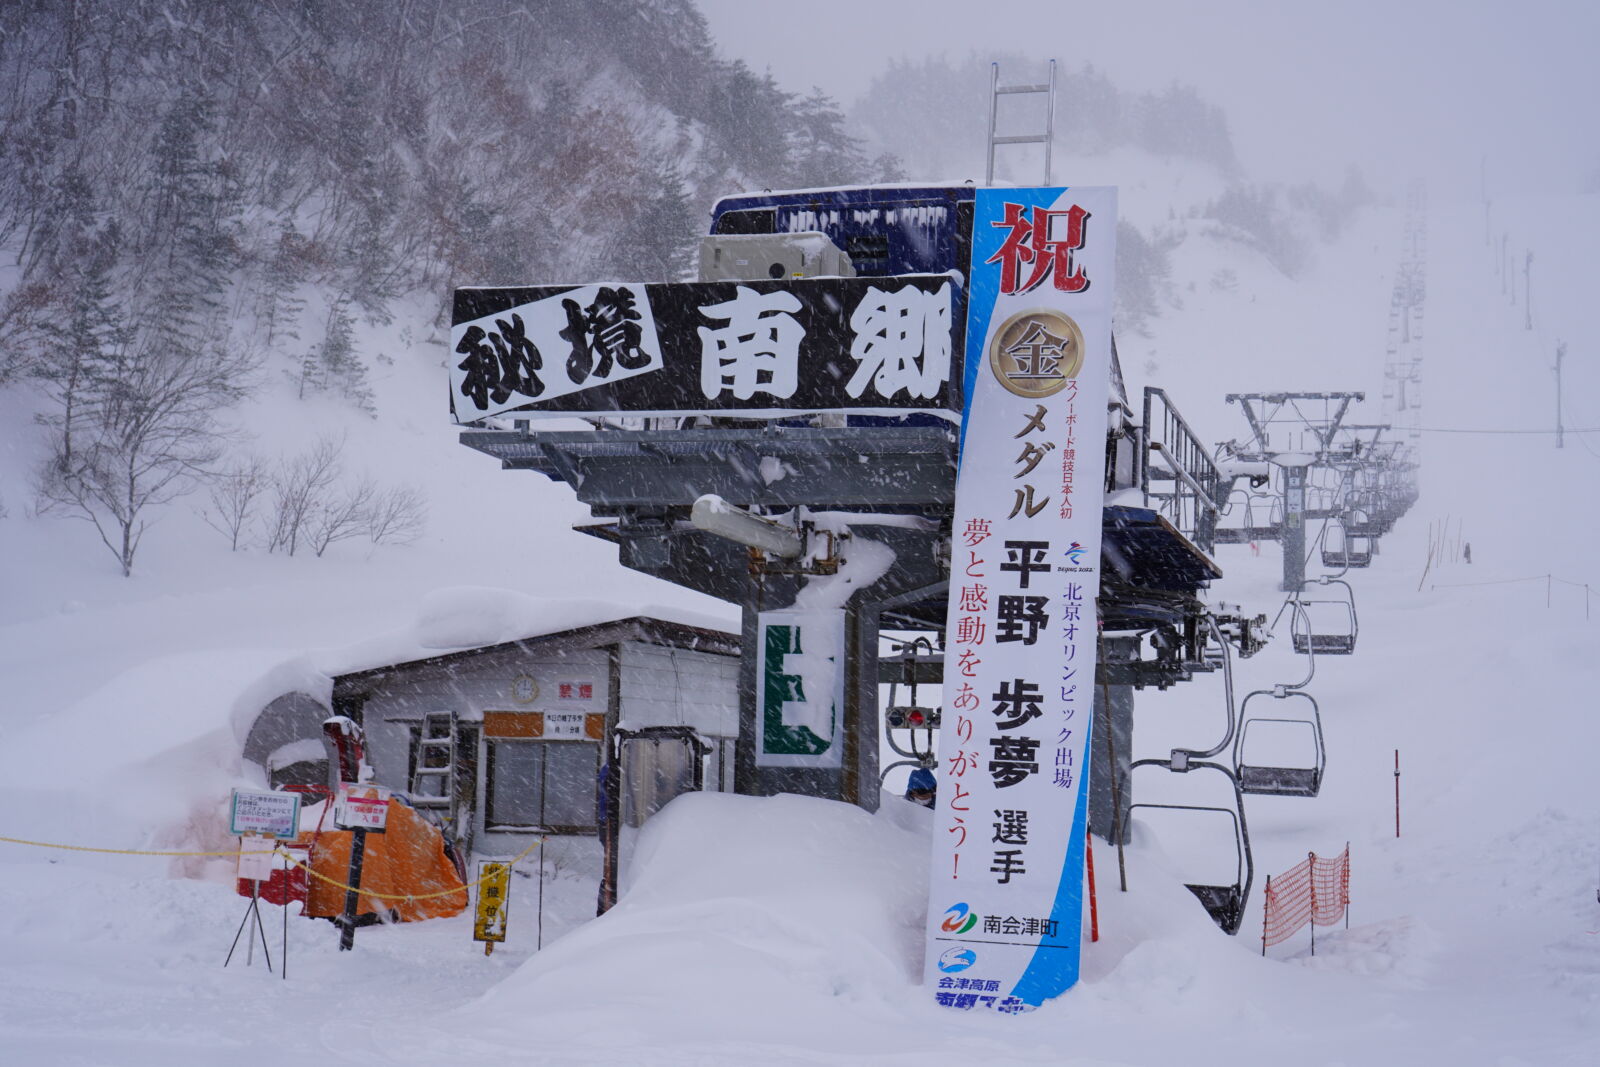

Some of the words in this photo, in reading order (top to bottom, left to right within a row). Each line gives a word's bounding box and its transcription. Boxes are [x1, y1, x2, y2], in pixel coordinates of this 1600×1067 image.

[985, 202, 1091, 295] 祝
[455, 286, 652, 411] 秘境
[696, 281, 953, 401] 南郷
[1005, 320, 1069, 379] 金
[1059, 380, 1078, 519] スノーボード競技日本人初
[559, 683, 593, 699] 禁煙
[1052, 582, 1083, 789] 北京オリンピック出場
[983, 915, 1059, 937] 南会津町
[938, 976, 1001, 992] 会津高原
